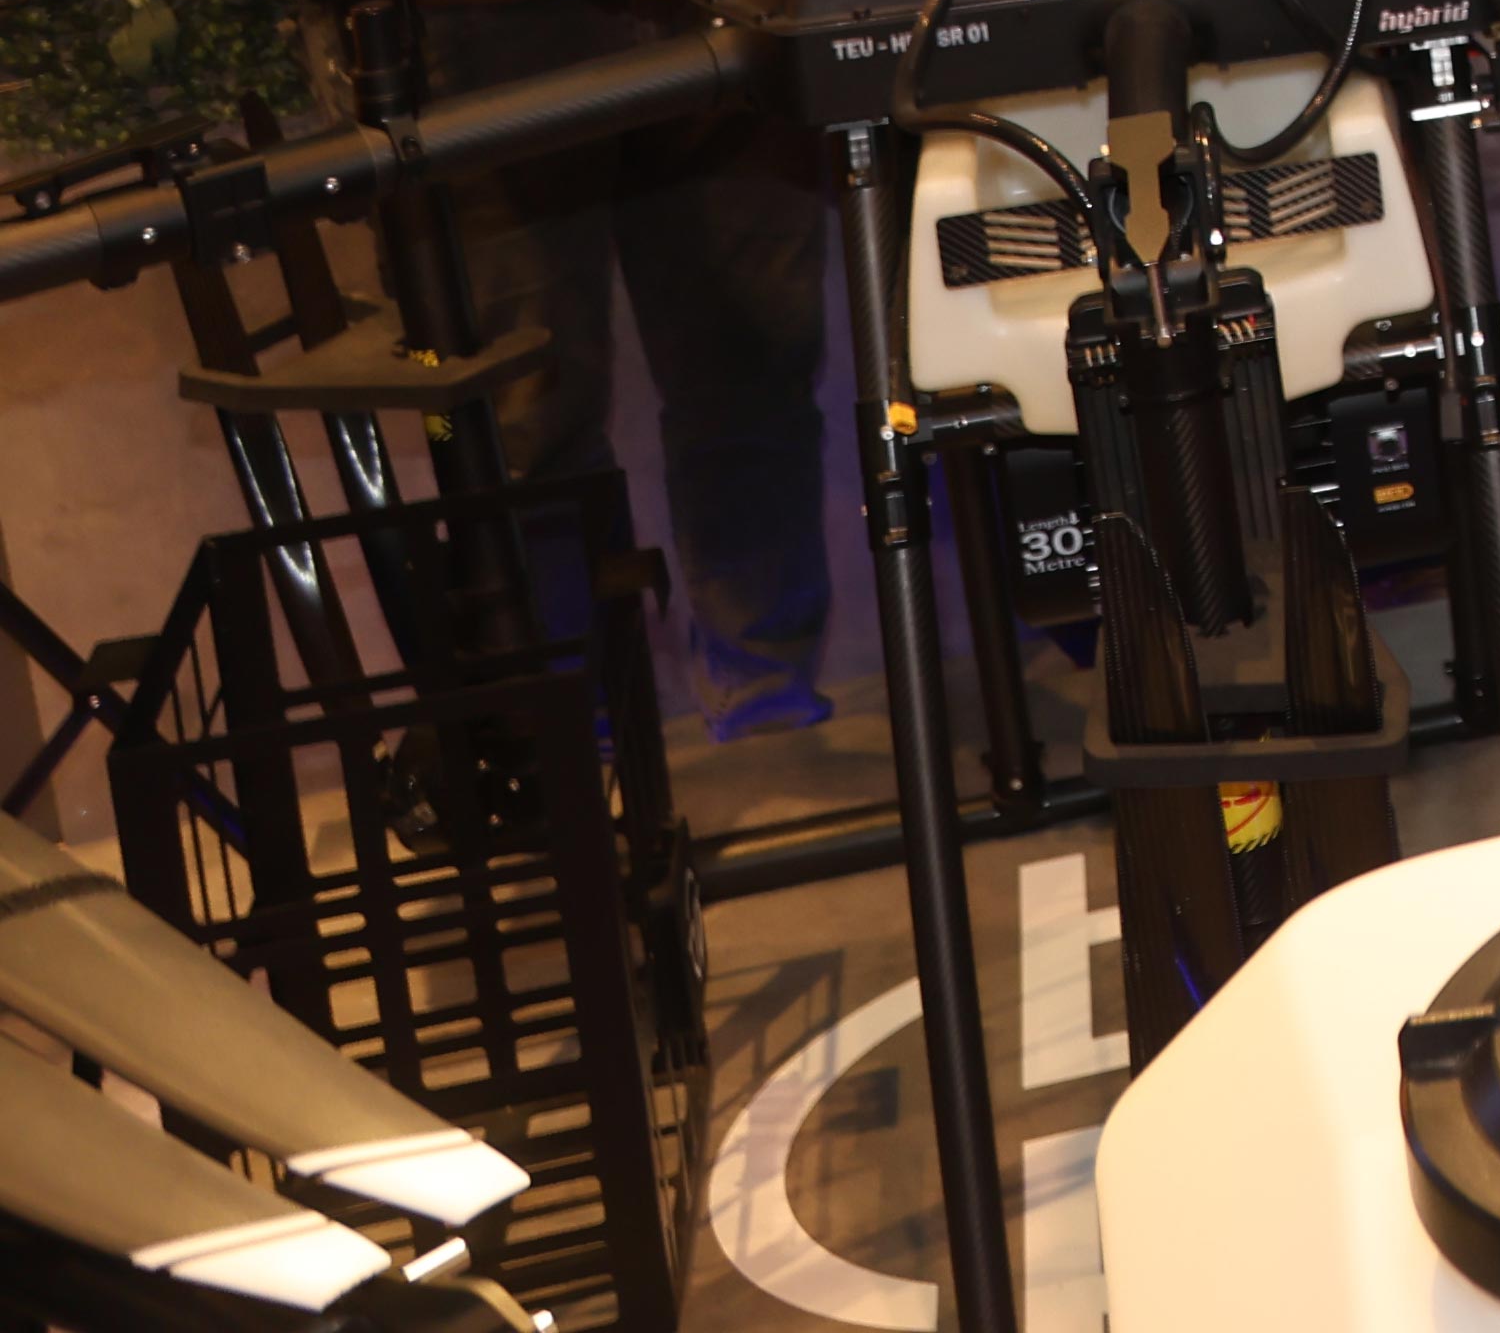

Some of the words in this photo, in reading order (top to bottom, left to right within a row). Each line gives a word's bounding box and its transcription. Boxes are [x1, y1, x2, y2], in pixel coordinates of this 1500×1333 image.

[832, 36, 874, 61] TEU
[1018, 516, 1069, 533] Length
[1020, 525, 1084, 562] 30
[1024, 556, 1086, 576] Metre
